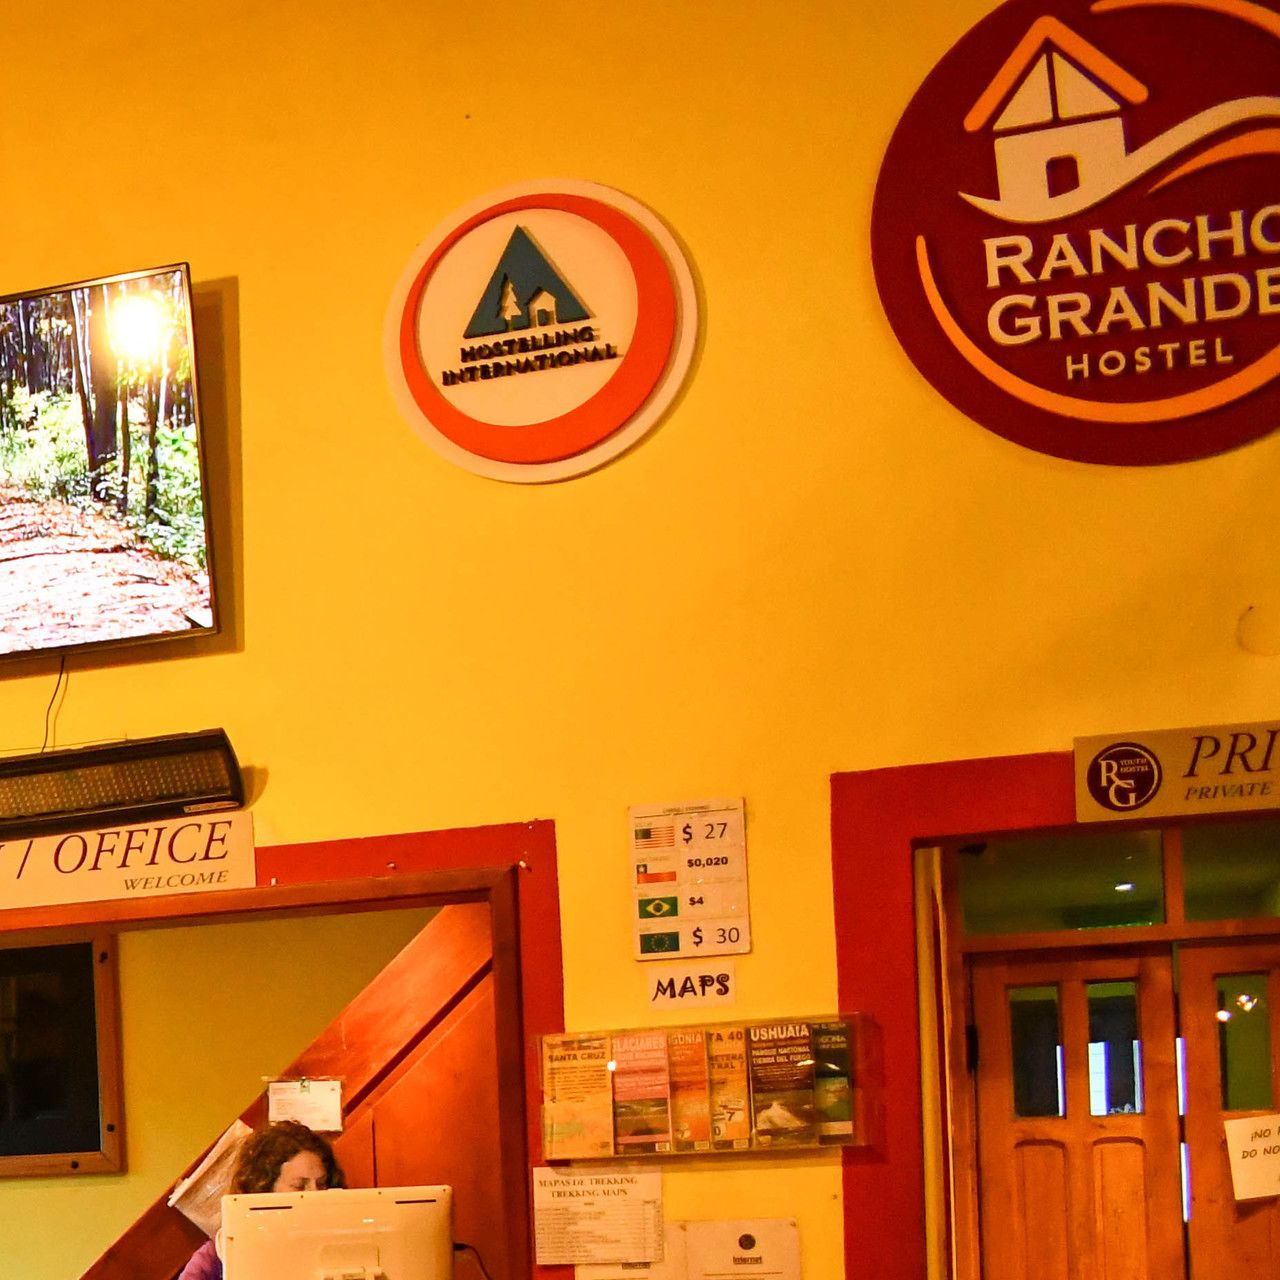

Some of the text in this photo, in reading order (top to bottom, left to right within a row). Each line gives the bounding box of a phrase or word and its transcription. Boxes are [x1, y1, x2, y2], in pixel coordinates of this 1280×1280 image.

[983, 204, 1280, 289] RANCHO
[987, 268, 1280, 346] GRANDE
[460, 325, 598, 363] HOSTELLING
[442, 343, 618, 386] INTERNATIONAL
[1065, 338, 1233, 381] HOSTEL
[1185, 781, 1273, 801] PRIVATE
[682, 822, 728, 844] $ 27
[53, 819, 234, 875] OFFICE
[123, 869, 229, 892] WELCOME
[693, 926, 740, 947] $ 30
[652, 973, 730, 1001] MAPS
[750, 1024, 810, 1042] USHUAIA
[548, 1051, 606, 1063] SANTA CRUZ
[1241, 1149, 1258, 1159] DO
[539, 1179, 571, 1188] MAPAS
[590, 1177, 638, 1186] TREKKING
[552, 1189, 628, 1198] TREKKING MAPS
